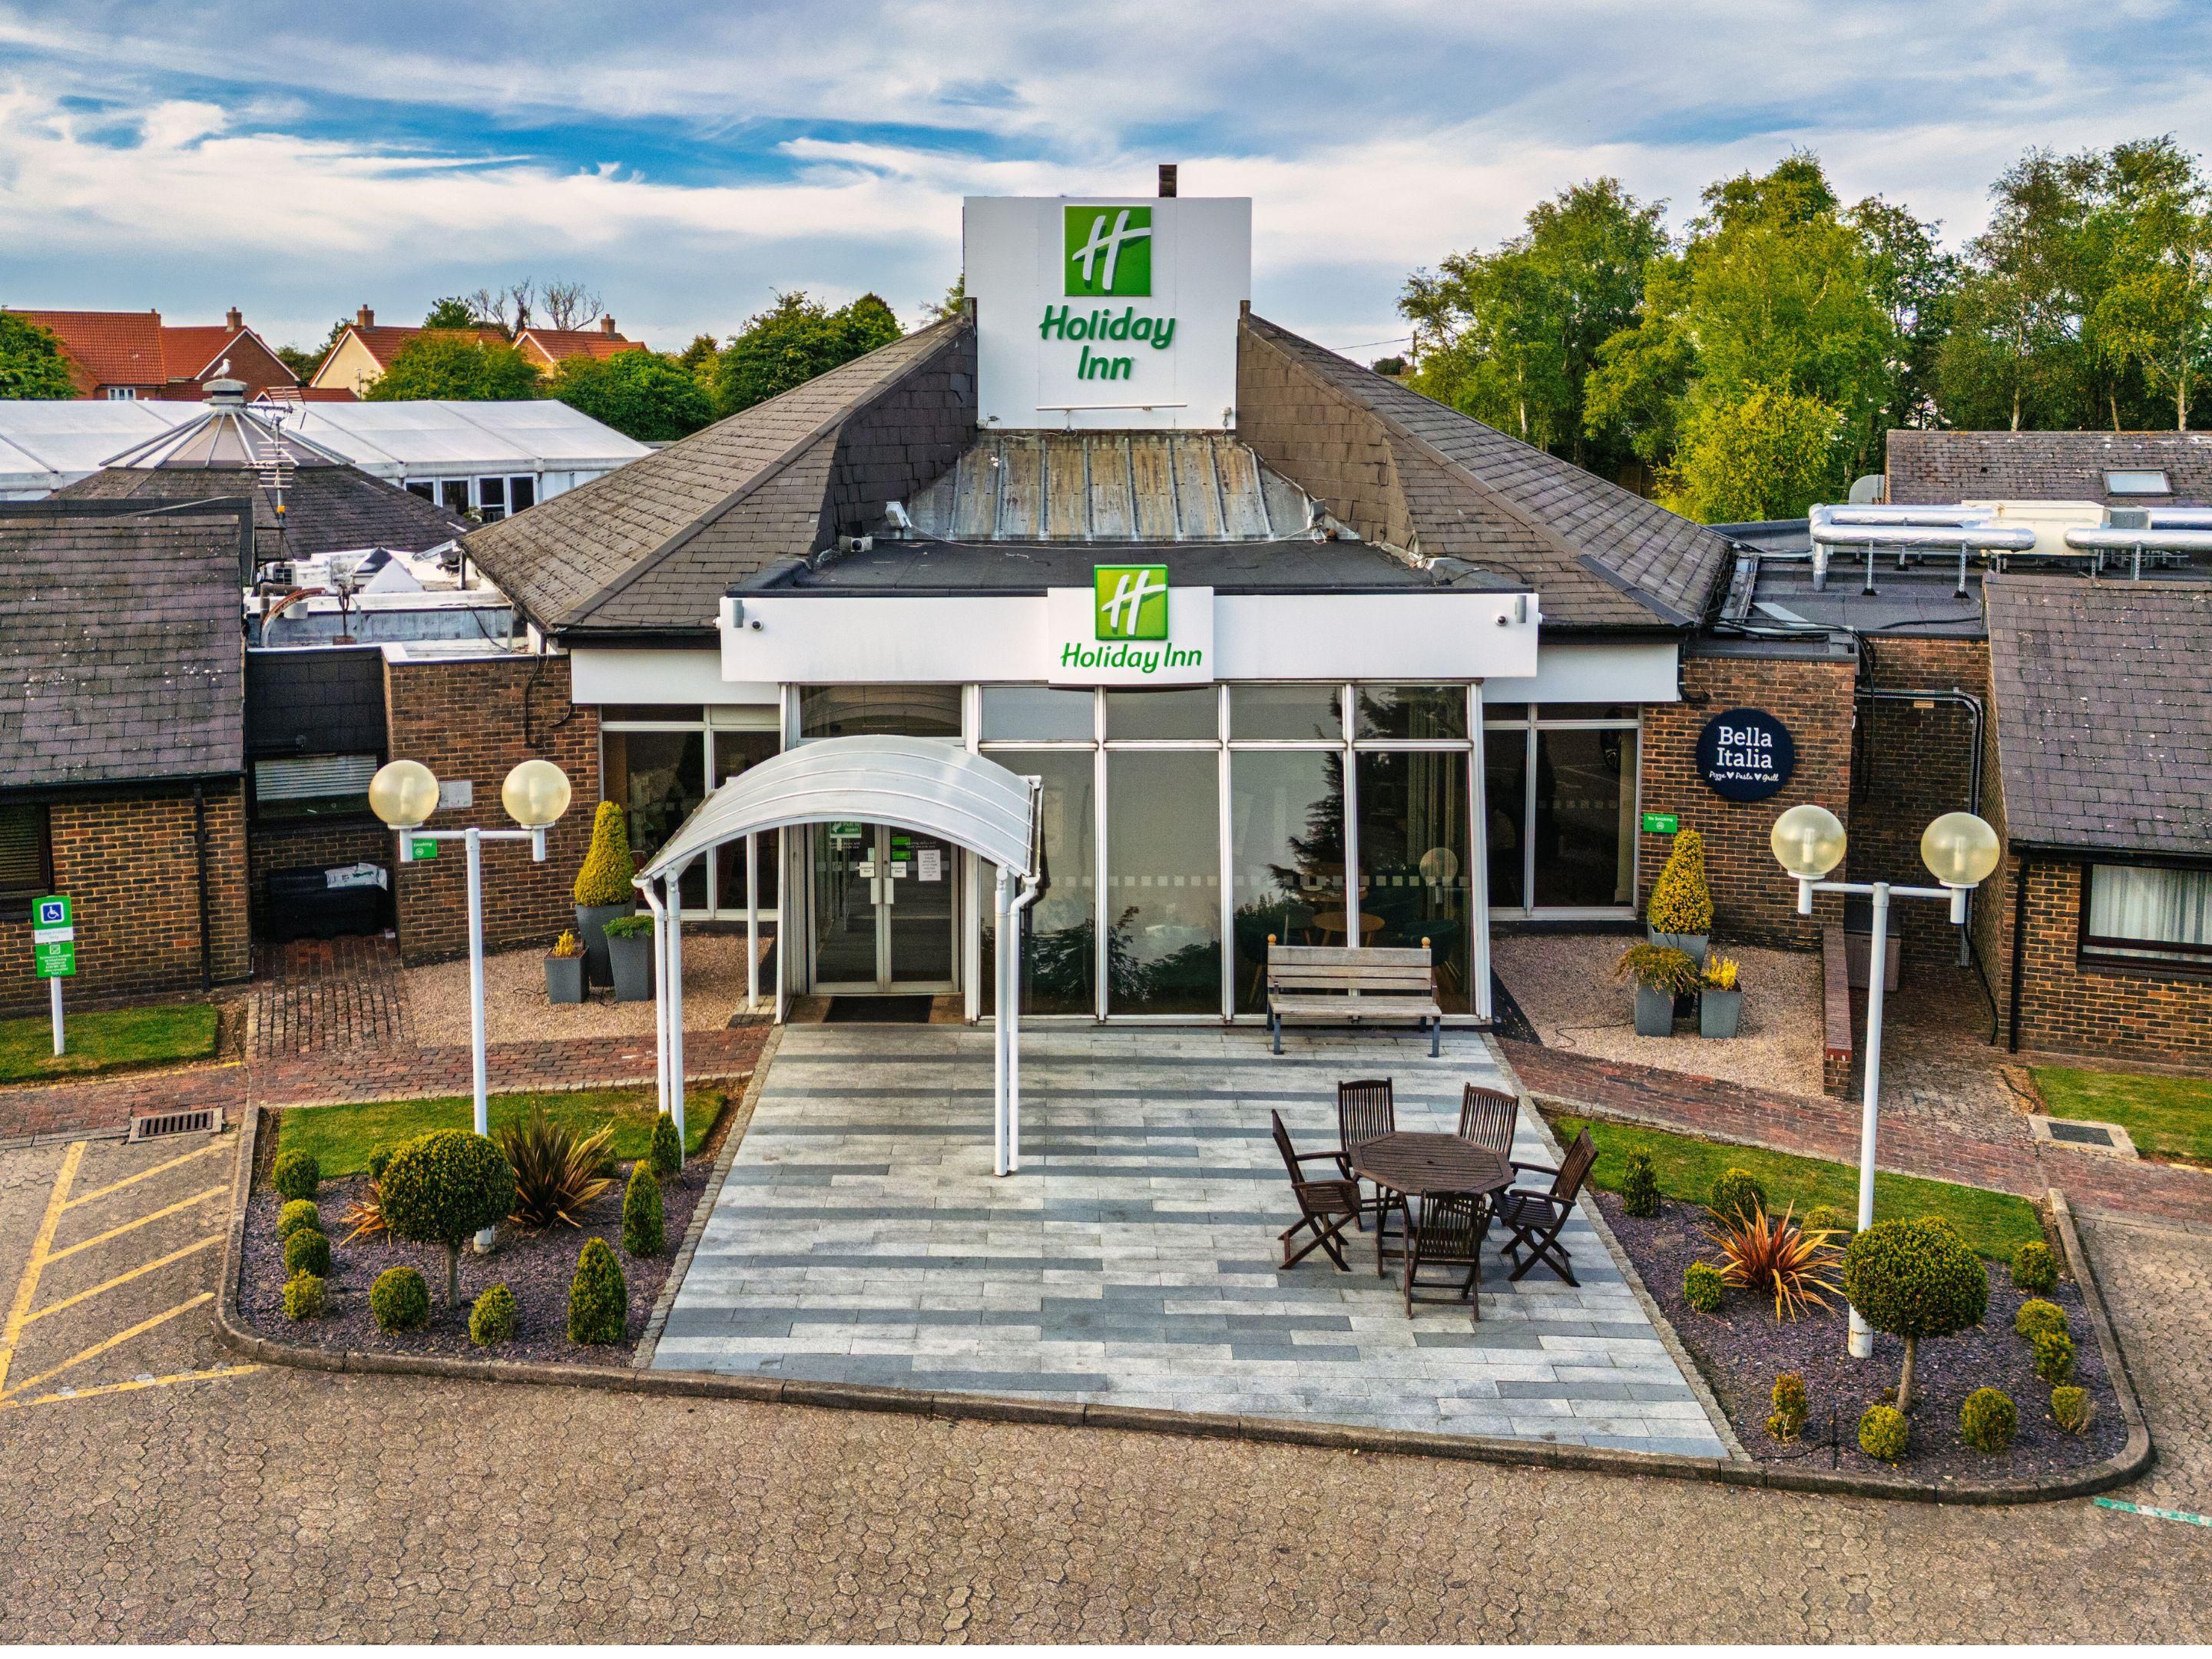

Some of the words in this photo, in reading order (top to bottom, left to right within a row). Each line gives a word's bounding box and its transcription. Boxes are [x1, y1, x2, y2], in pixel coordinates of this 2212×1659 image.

[1038, 304, 1176, 349] Holiday
[1077, 346, 1133, 379] Inn
[1060, 642, 1160, 674] Holiday
[1164, 642, 1203, 667] Inn
[1718, 726, 1773, 747] Bella
[1716, 747, 1773, 768] Italia
[1709, 770, 1727, 781] Pizza
[1735, 772, 1753, 780] Pasta
[1762, 773, 1780, 782] Grill
